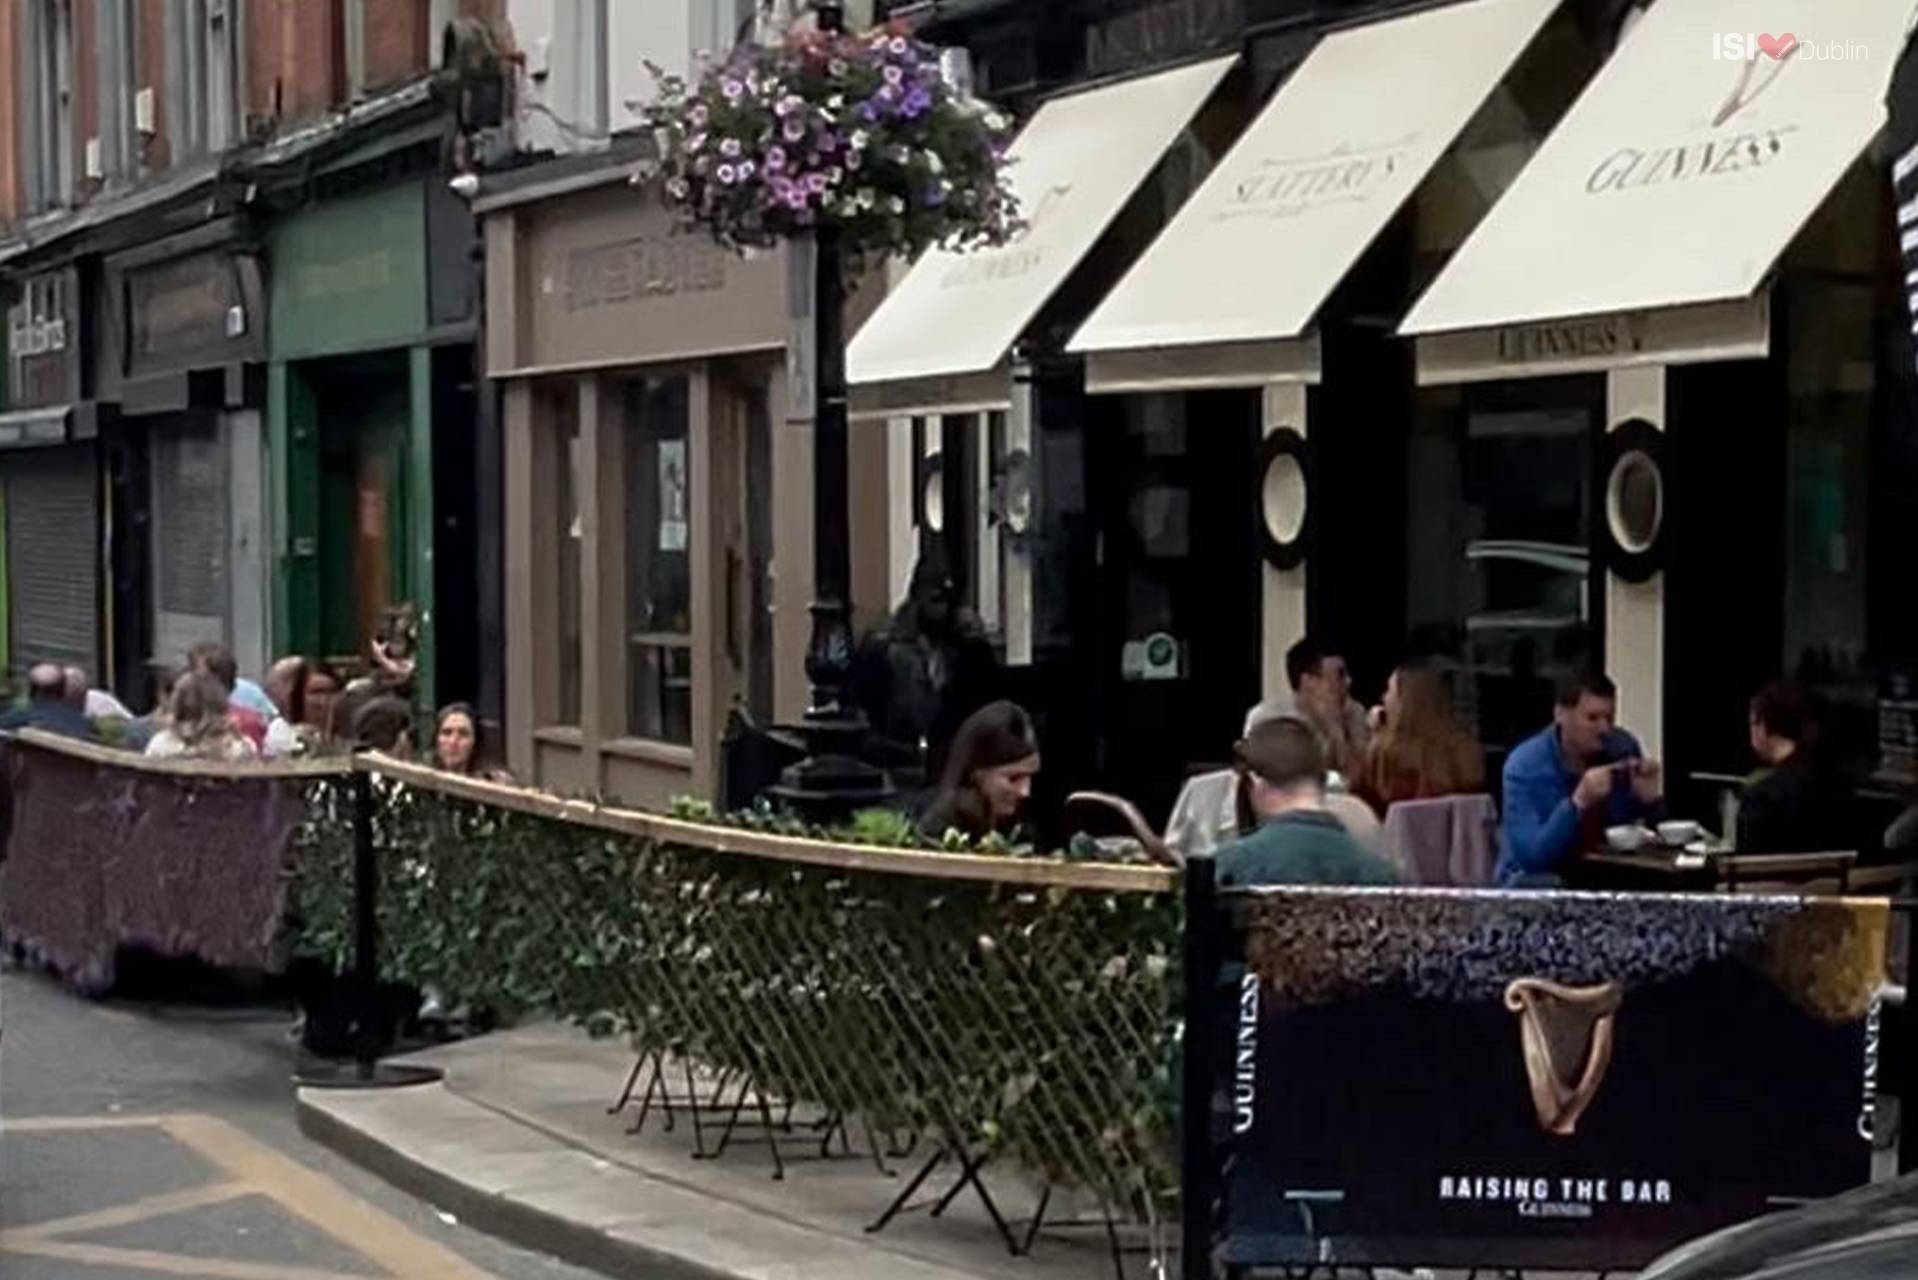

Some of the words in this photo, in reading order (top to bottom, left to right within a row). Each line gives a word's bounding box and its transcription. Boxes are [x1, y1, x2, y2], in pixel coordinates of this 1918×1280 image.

[1233, 972, 1260, 1134] GUINNESS
[1439, 1176, 1549, 1199] RAISING
[1560, 1178, 1608, 1201] THE
[1620, 1180, 1672, 1203] BAR
